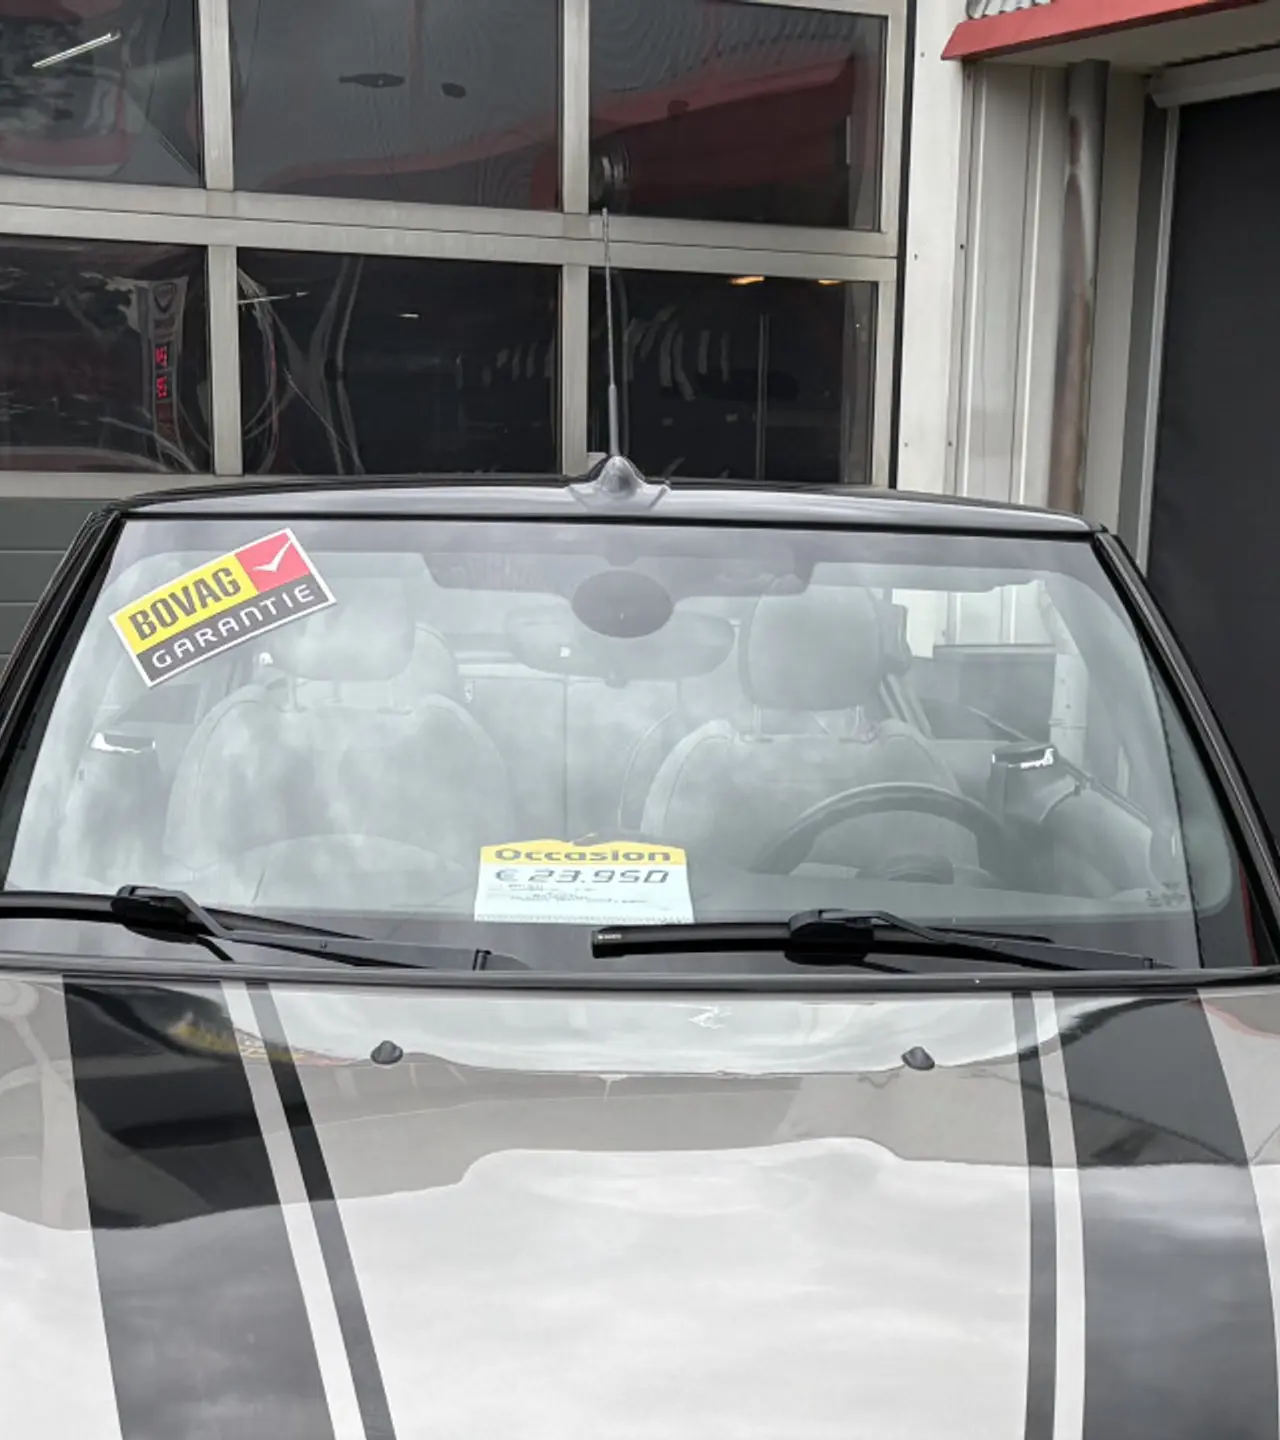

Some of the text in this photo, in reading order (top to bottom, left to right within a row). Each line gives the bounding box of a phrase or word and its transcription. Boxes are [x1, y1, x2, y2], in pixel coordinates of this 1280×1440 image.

[128, 567, 241, 641] BOVAG
[152, 584, 315, 668] GARANTIE
[495, 849, 671, 861] Occasion
[528, 869, 670, 884] 23.950
